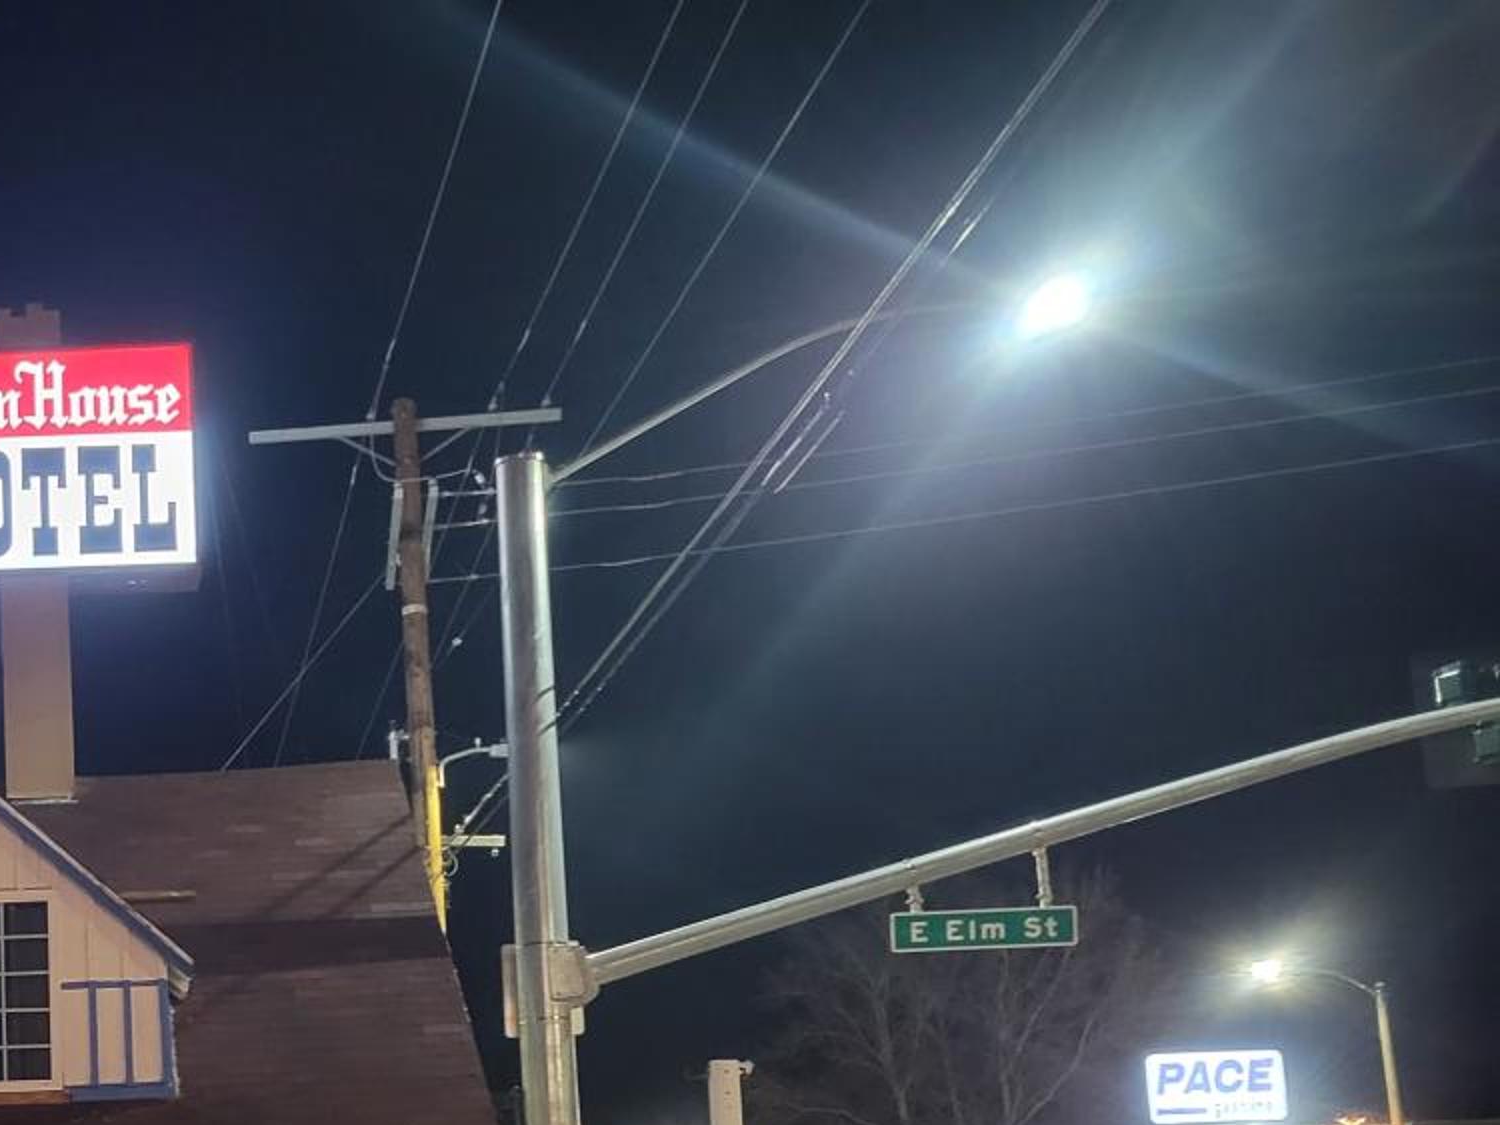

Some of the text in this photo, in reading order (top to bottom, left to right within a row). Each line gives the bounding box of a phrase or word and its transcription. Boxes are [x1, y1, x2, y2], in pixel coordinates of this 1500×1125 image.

[910, 916, 1059, 943] E Elm St
[1156, 1057, 1274, 1096] PACE
